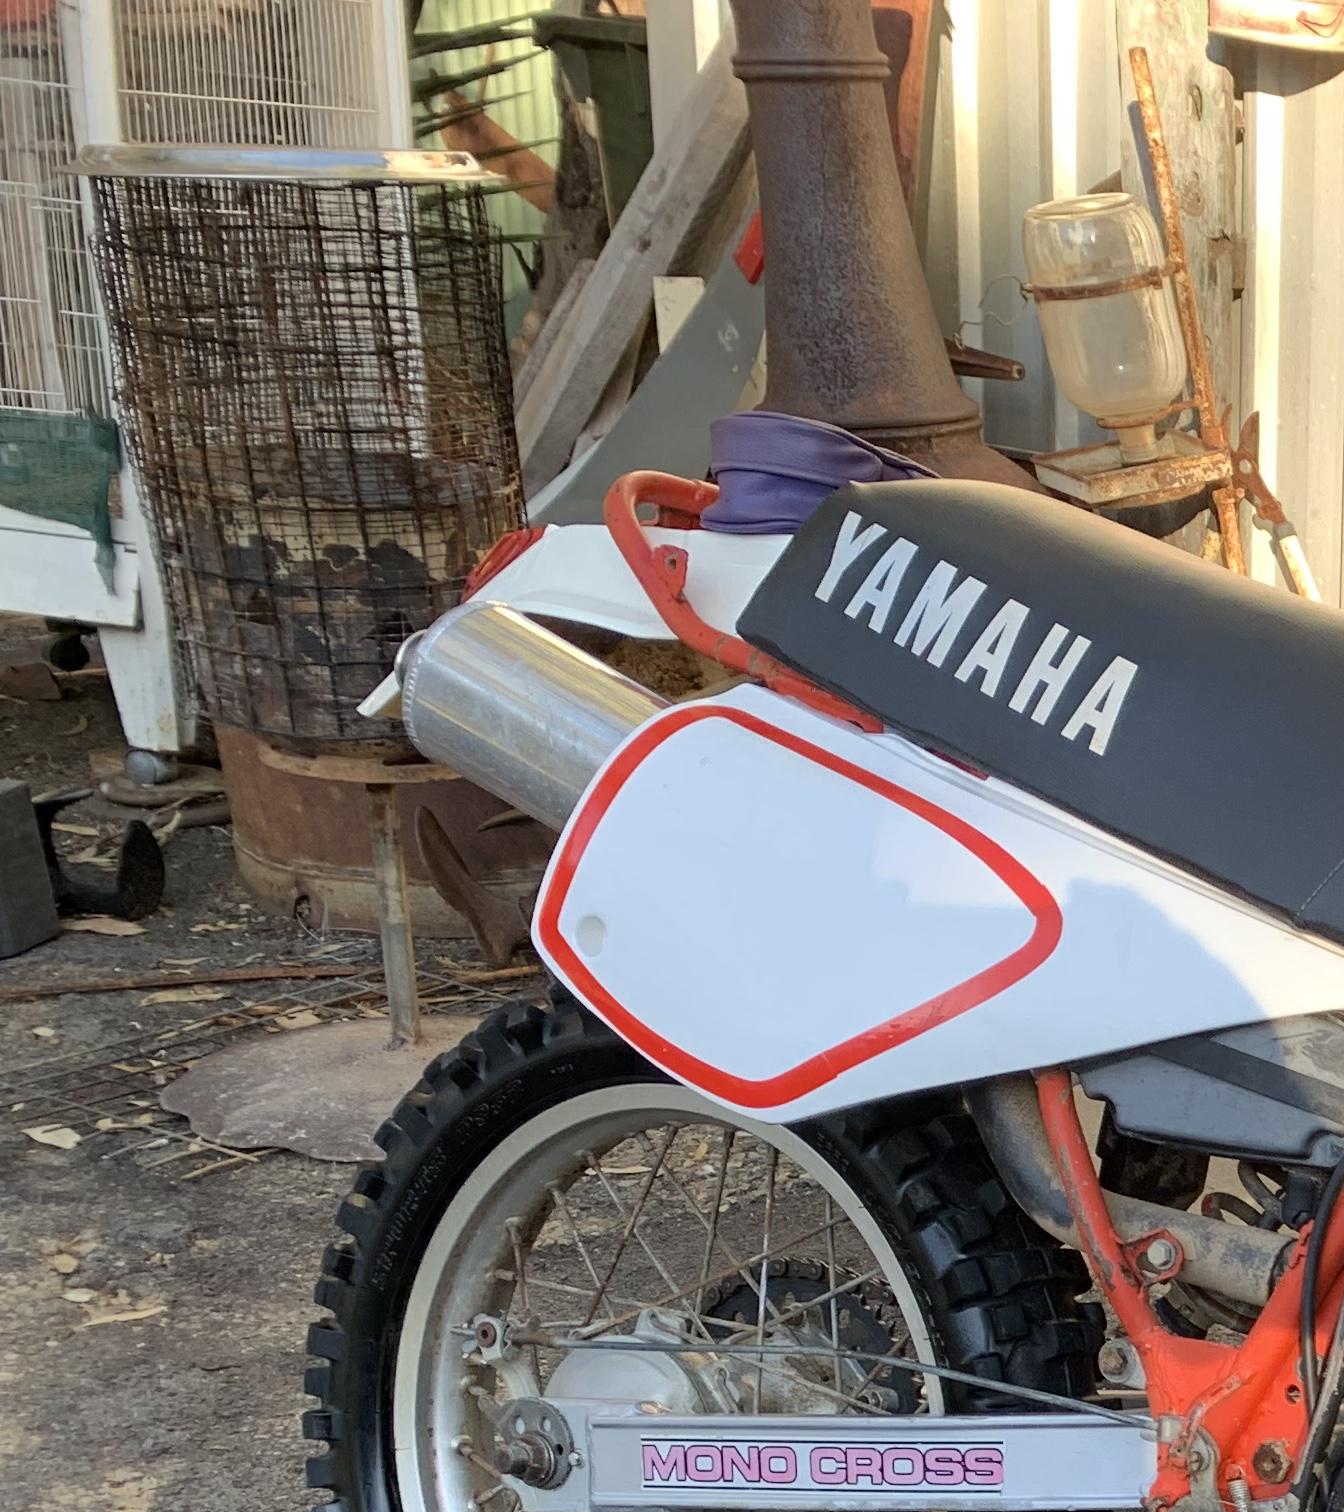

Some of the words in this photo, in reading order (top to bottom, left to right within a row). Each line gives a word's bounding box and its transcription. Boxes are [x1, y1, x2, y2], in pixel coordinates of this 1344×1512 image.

[814, 510, 1139, 756] YAMAHA
[642, 1445, 797, 1483] MONO
[810, 1447, 1004, 1485] CROSS
